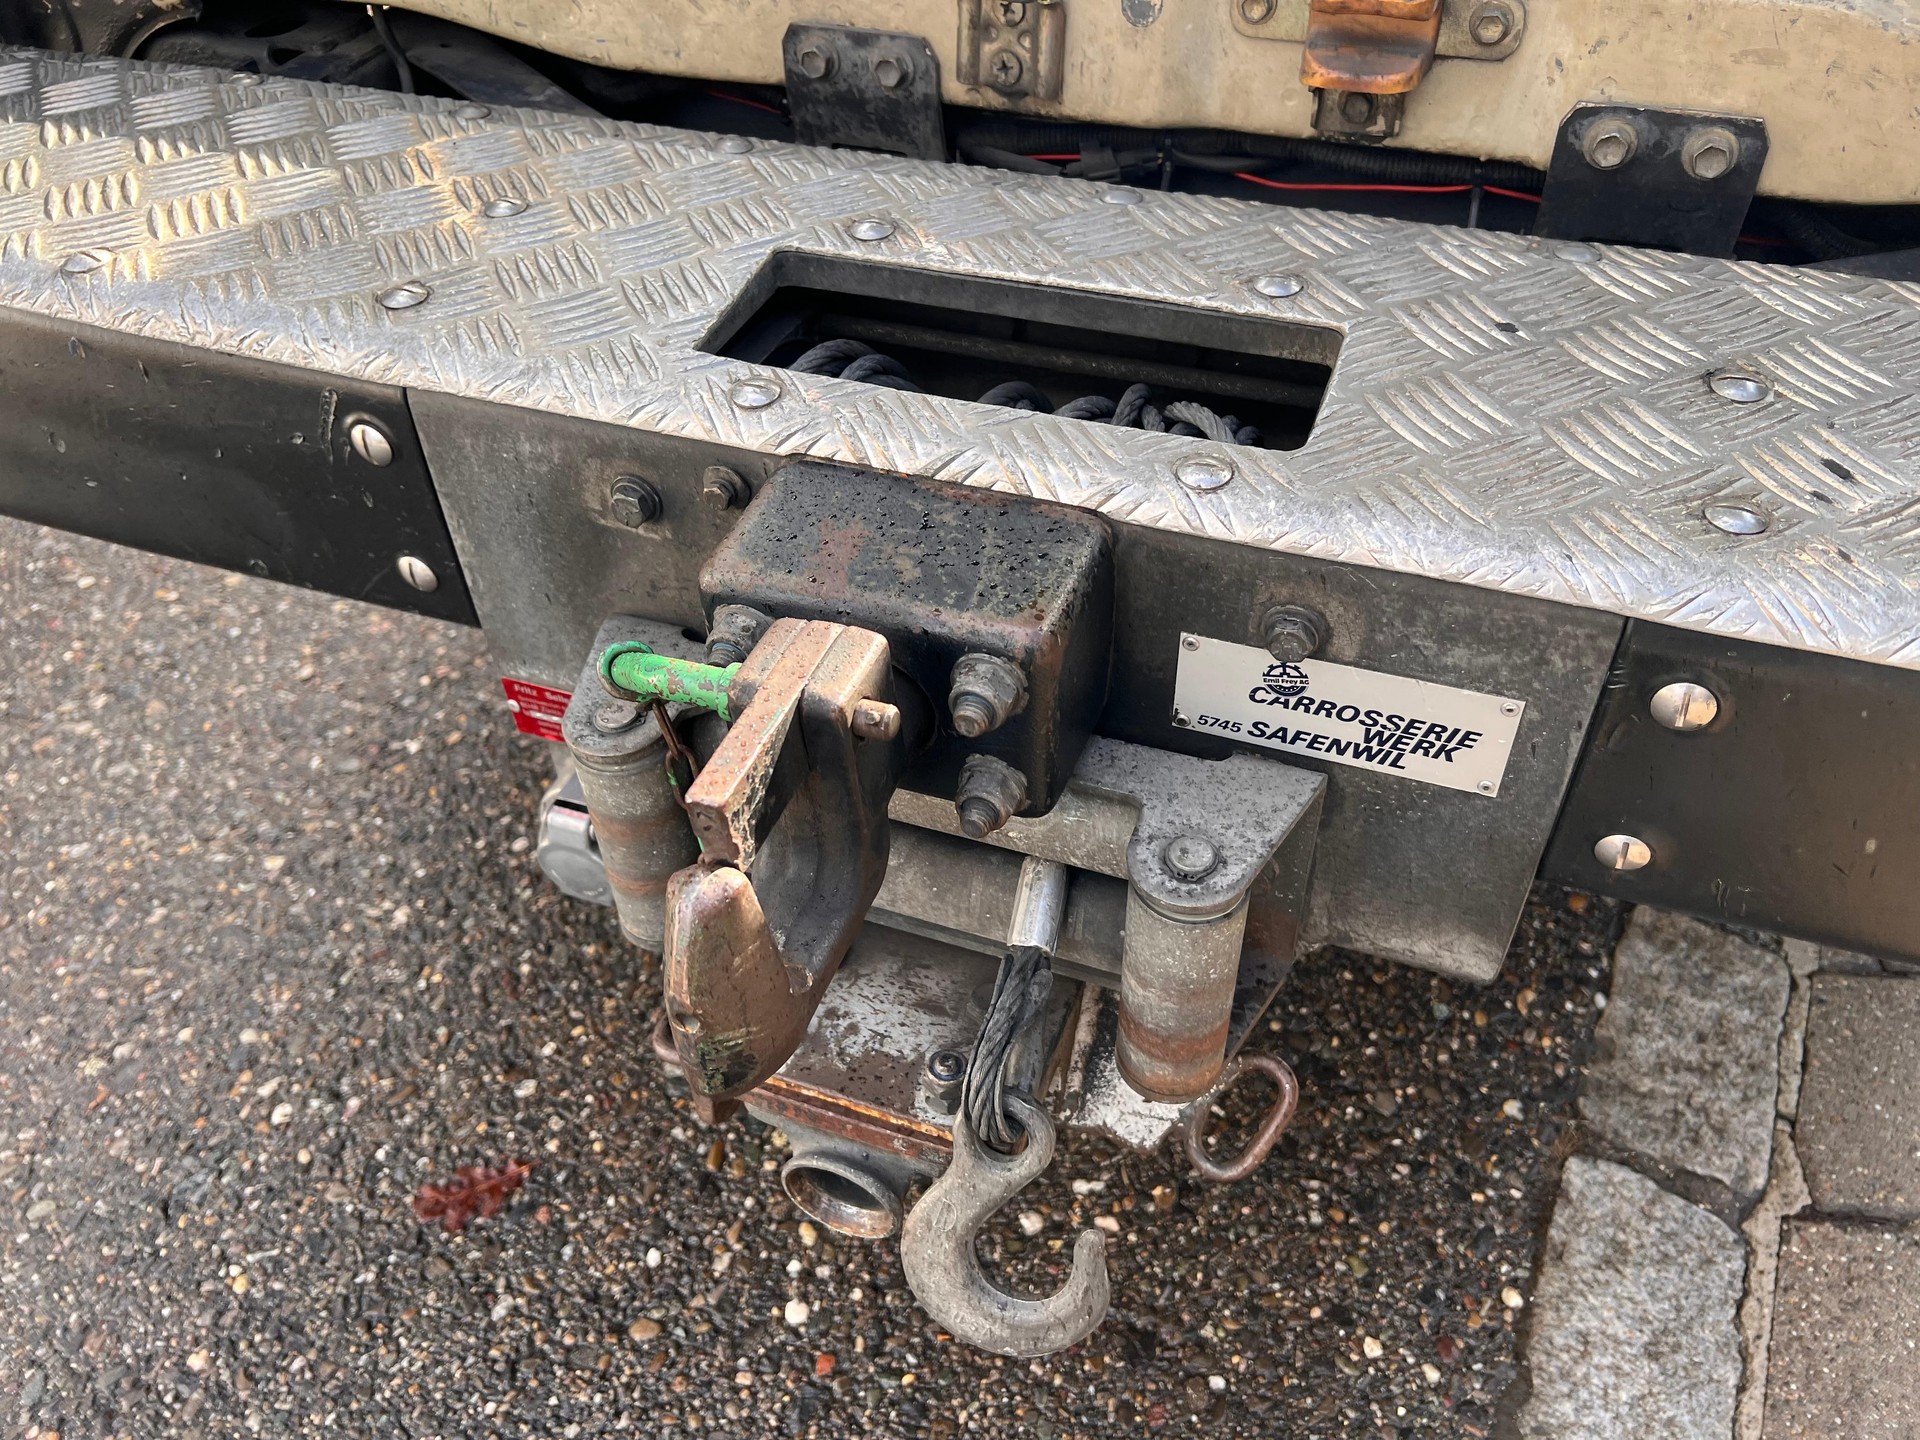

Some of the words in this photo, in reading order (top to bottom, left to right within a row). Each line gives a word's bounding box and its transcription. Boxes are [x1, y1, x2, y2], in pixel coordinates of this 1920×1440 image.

[1197, 714, 1243, 733] 5745
[1247, 721, 1408, 770] SAFENWIL
[1248, 686, 1484, 750] CARROSSERIE
[1363, 727, 1463, 763] WERK
